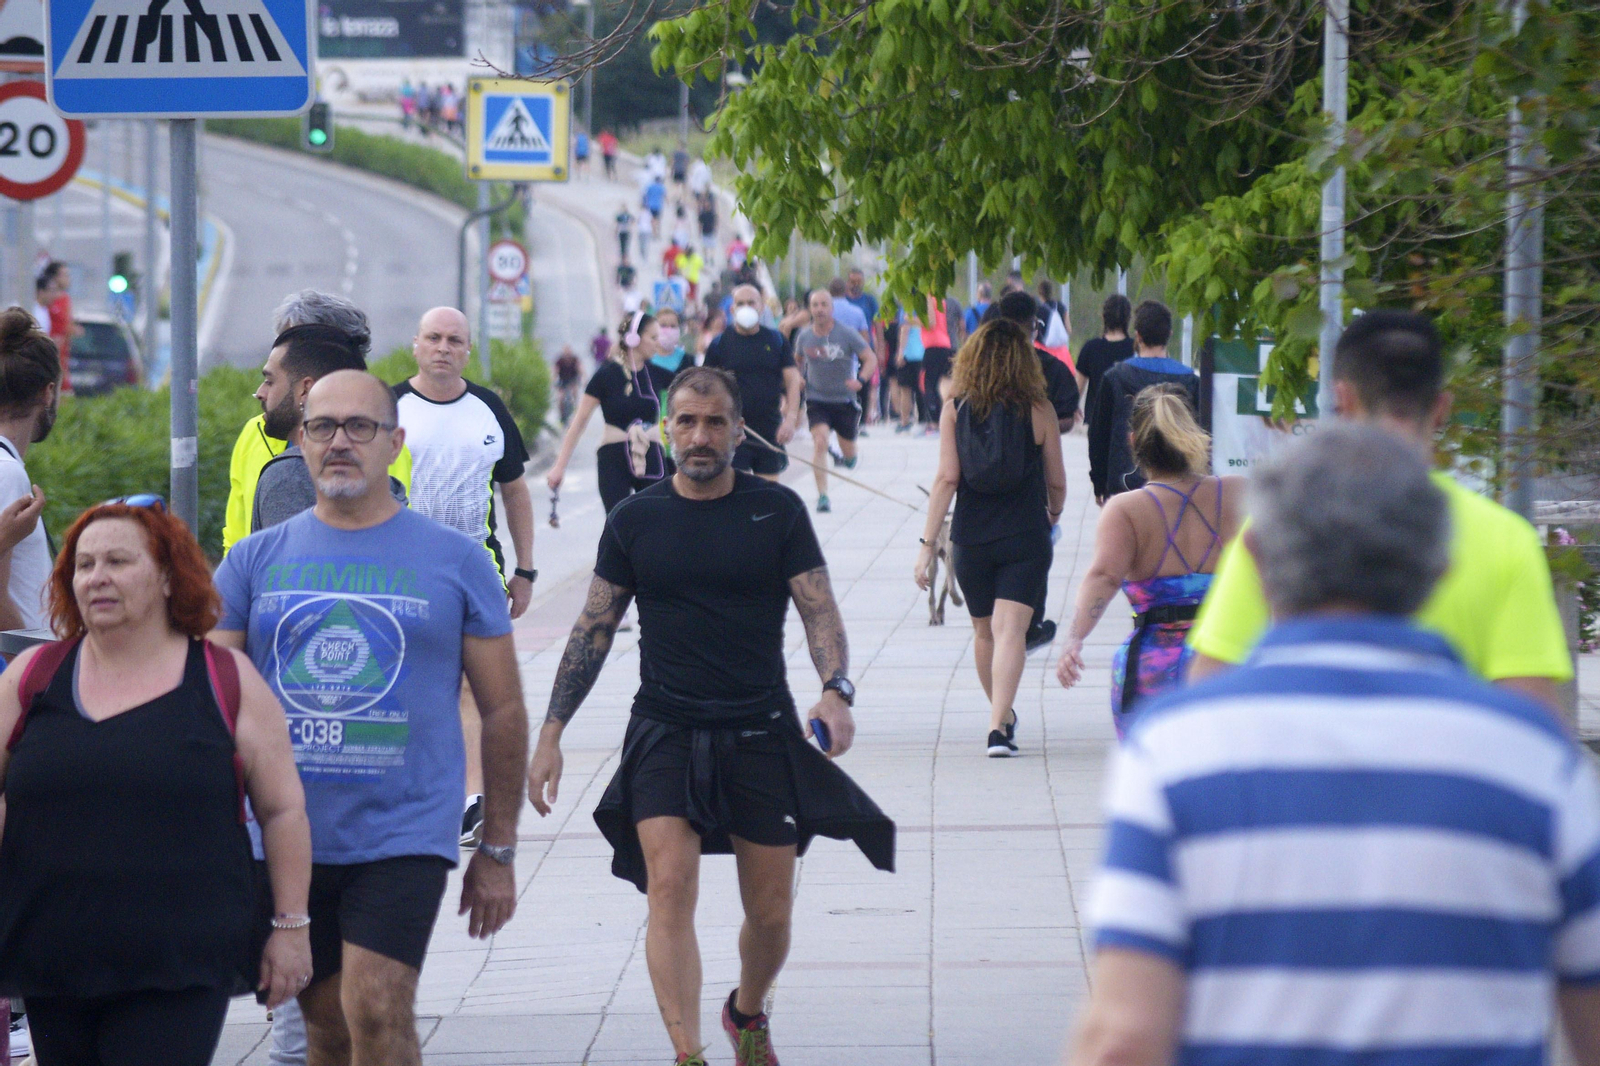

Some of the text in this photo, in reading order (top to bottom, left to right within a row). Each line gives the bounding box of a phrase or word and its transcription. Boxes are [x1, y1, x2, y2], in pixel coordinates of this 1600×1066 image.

[0, 121, 57, 158] 20
[1228, 459, 1249, 468] 900
[265, 561, 428, 598] TERMINAL
[321, 641, 355, 653] CHECK
[321, 651, 351, 661] POINT
